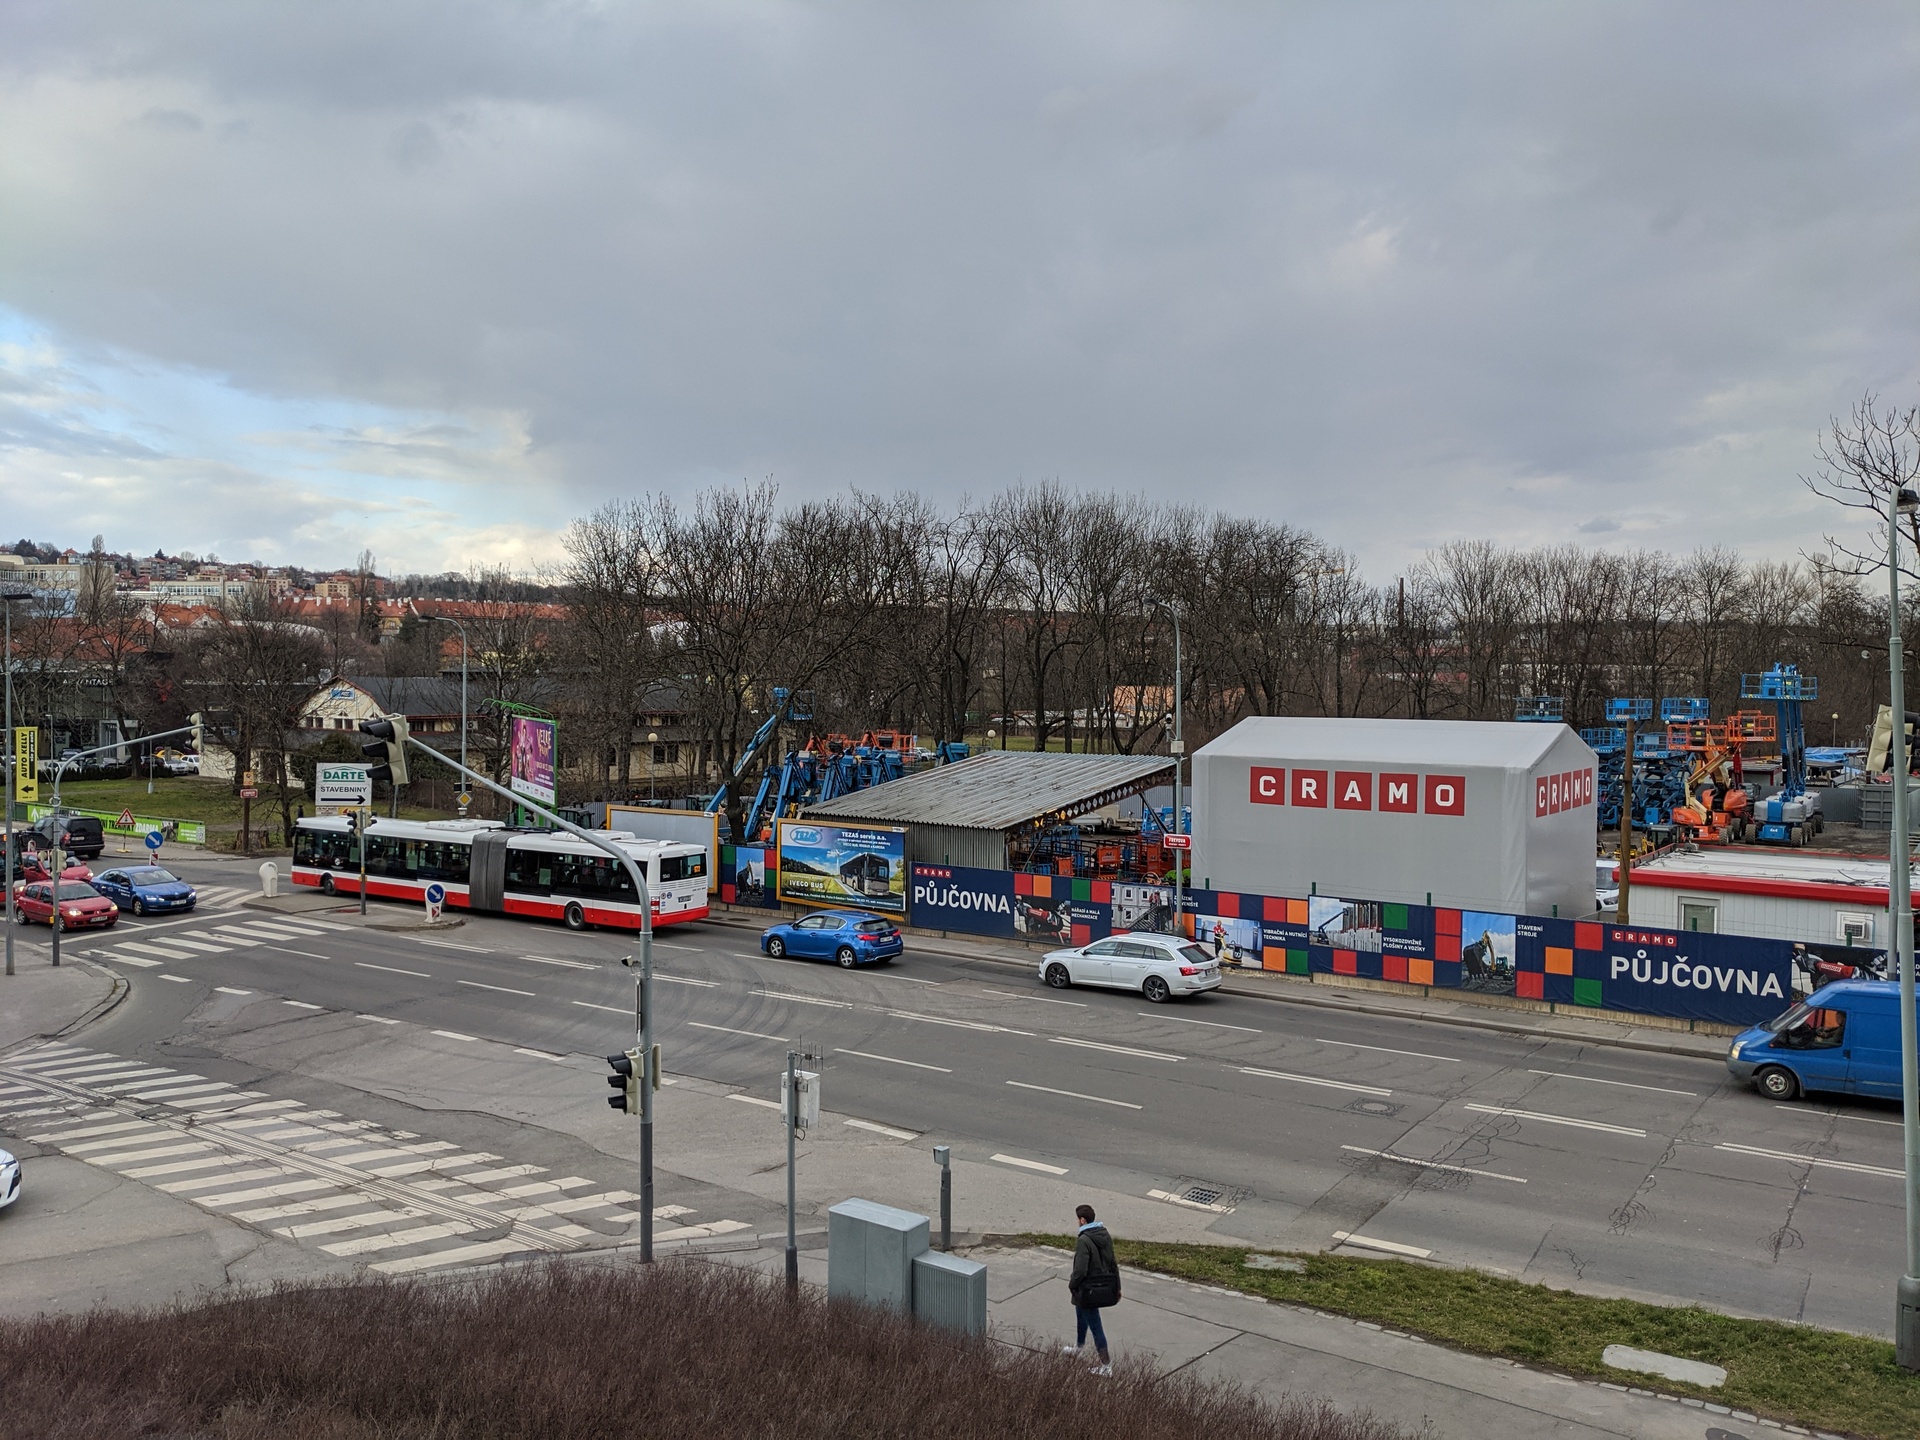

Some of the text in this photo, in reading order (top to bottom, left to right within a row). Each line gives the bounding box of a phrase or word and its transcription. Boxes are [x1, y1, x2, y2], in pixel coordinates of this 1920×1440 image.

[323, 771, 365, 780] DARTE
[1259, 774, 1455, 807] CRAMO
[1538, 776, 1592, 808] CRAMO
[916, 868, 950, 877] CRAMO
[914, 880, 1010, 914] PŮJČOVNA
[1517, 924, 1543, 932] STAVEBNÍ
[1382, 936, 1422, 946] VYSOKOZDVIŽNÉ
[1614, 932, 1674, 945] CRAMO
[1611, 949, 1784, 998] PŮJČOVNA
